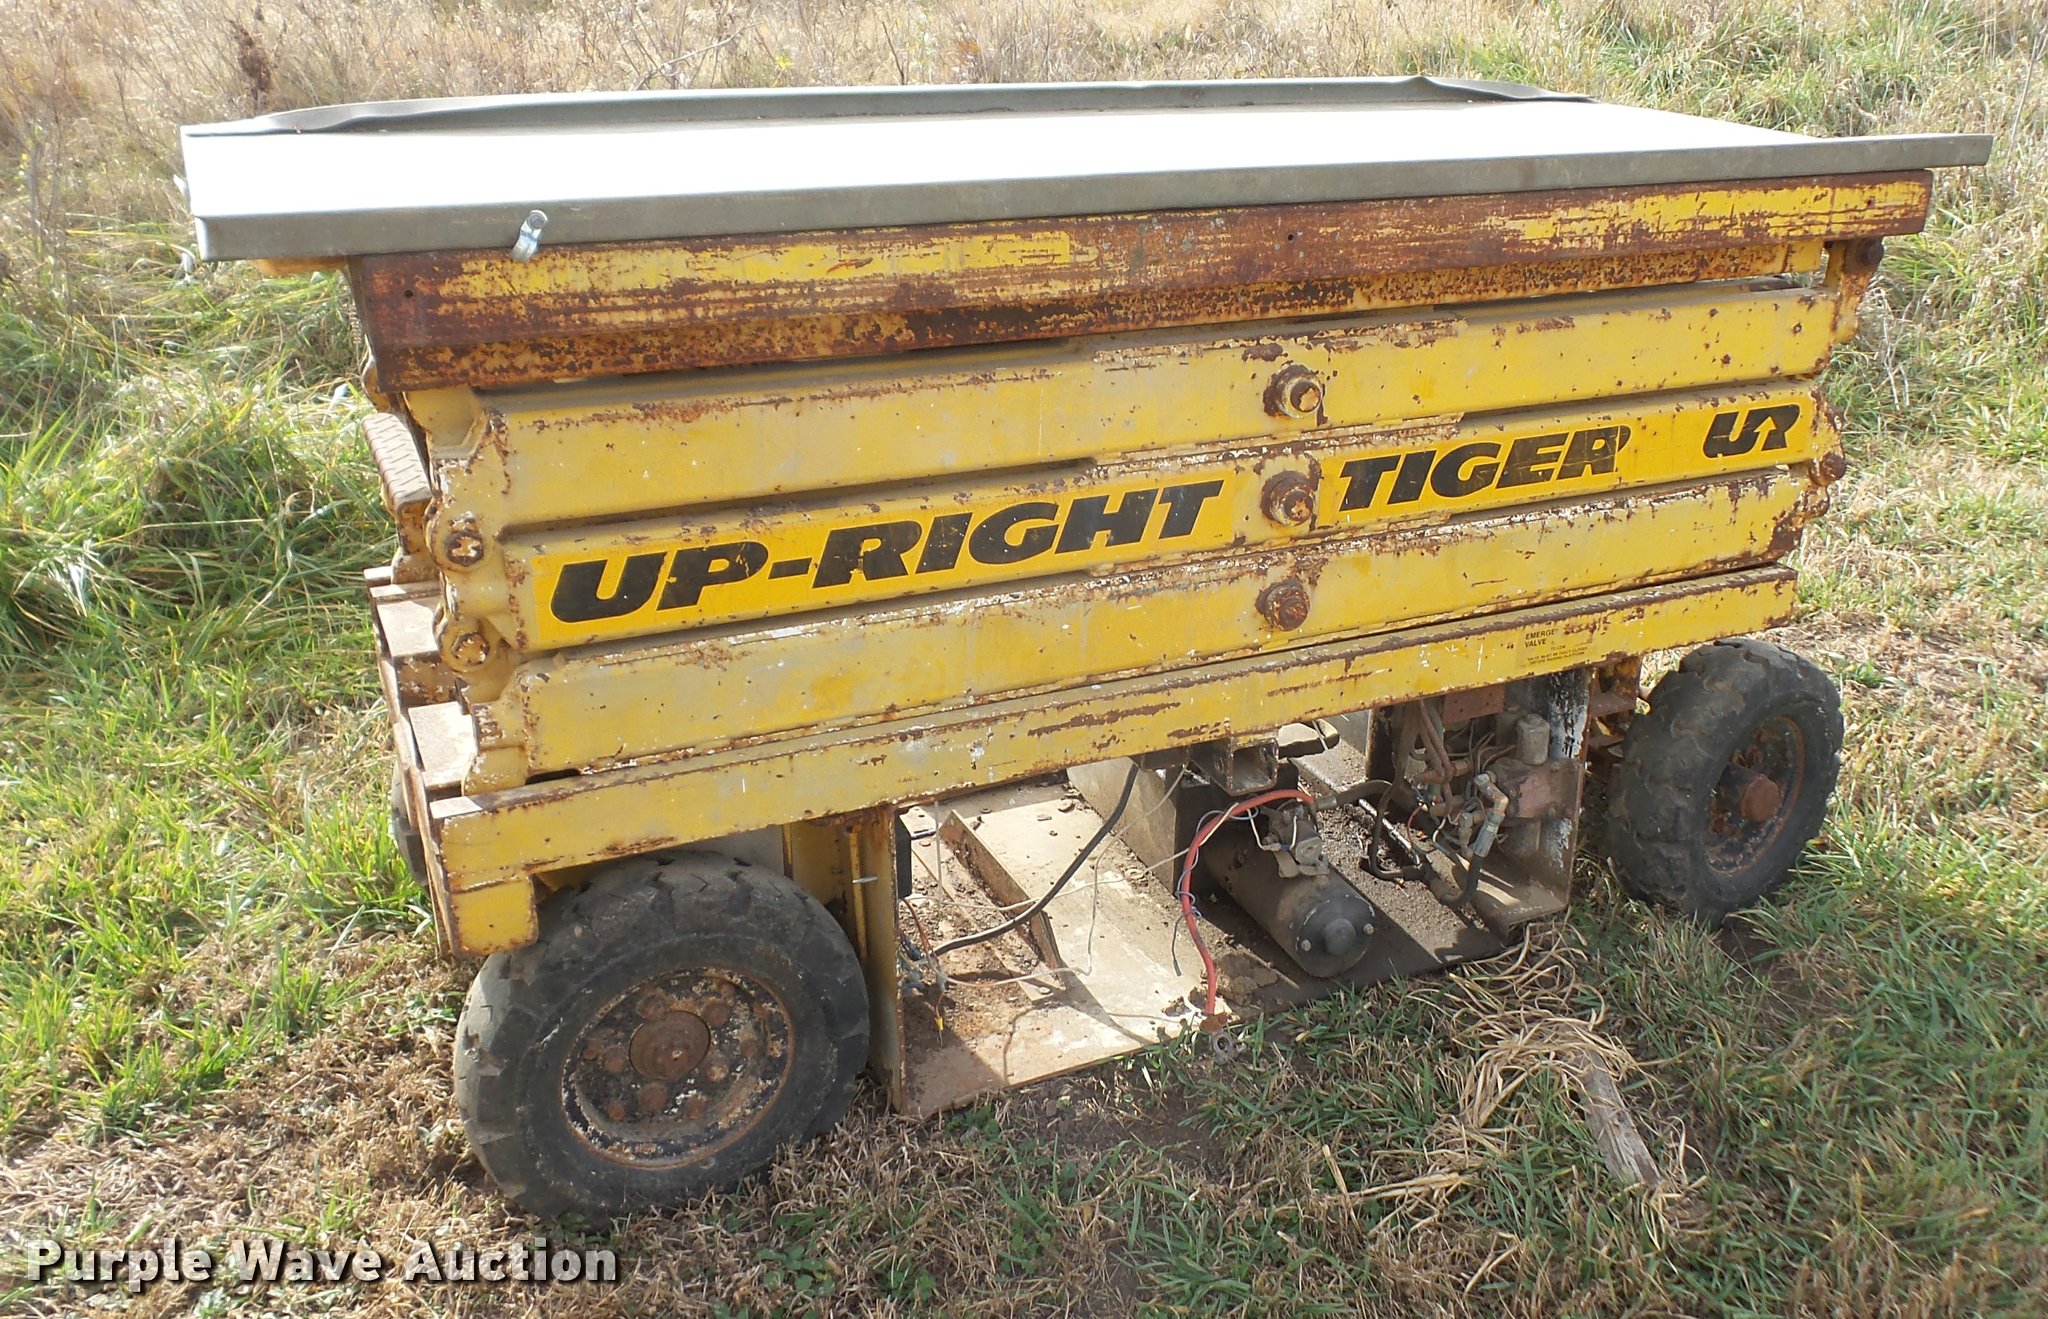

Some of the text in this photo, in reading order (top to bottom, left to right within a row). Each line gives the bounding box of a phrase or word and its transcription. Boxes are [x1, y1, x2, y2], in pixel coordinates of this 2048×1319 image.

[550, 424, 1631, 624] UP-RIGHT TIGER
[1525, 628, 1559, 640] EMERGE
[1524, 637, 1547, 649] VALVE
